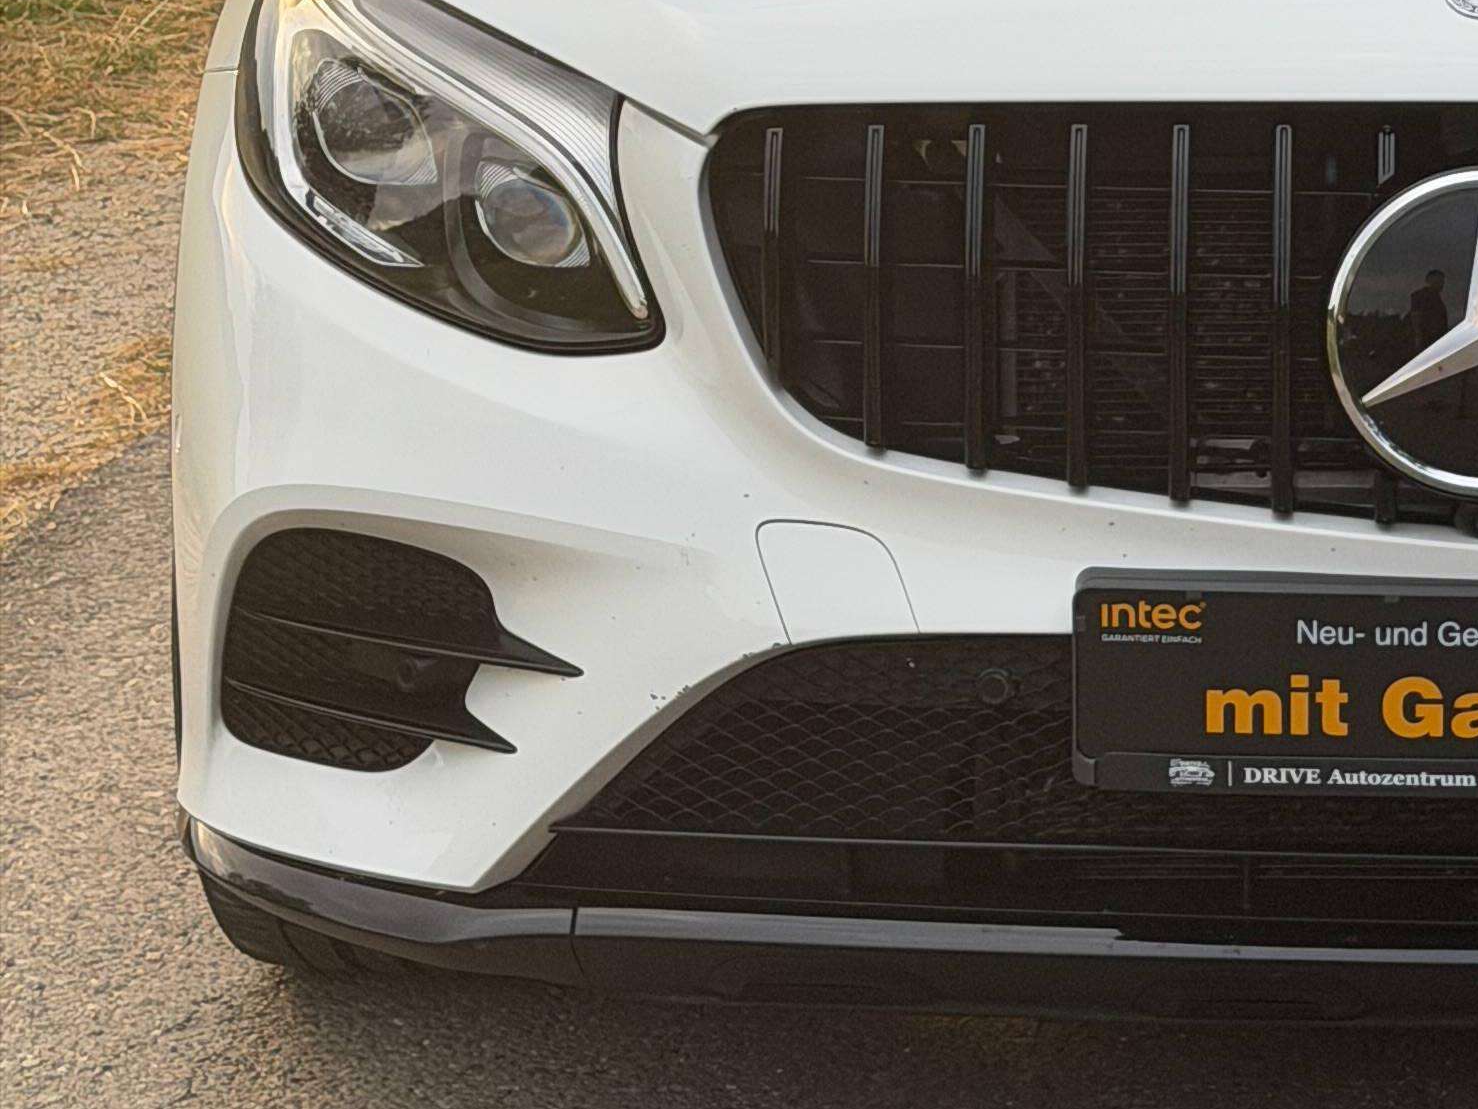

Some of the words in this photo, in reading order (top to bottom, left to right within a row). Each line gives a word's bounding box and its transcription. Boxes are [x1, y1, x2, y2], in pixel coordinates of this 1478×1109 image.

[1101, 600, 1203, 630] intec
[1297, 619, 1366, 645] Neu-
[1375, 621, 1428, 646] und
[1205, 674, 1349, 737] mit
[1243, 767, 1322, 785] DRIVE
[1326, 768, 1477, 787] Autozentrum
